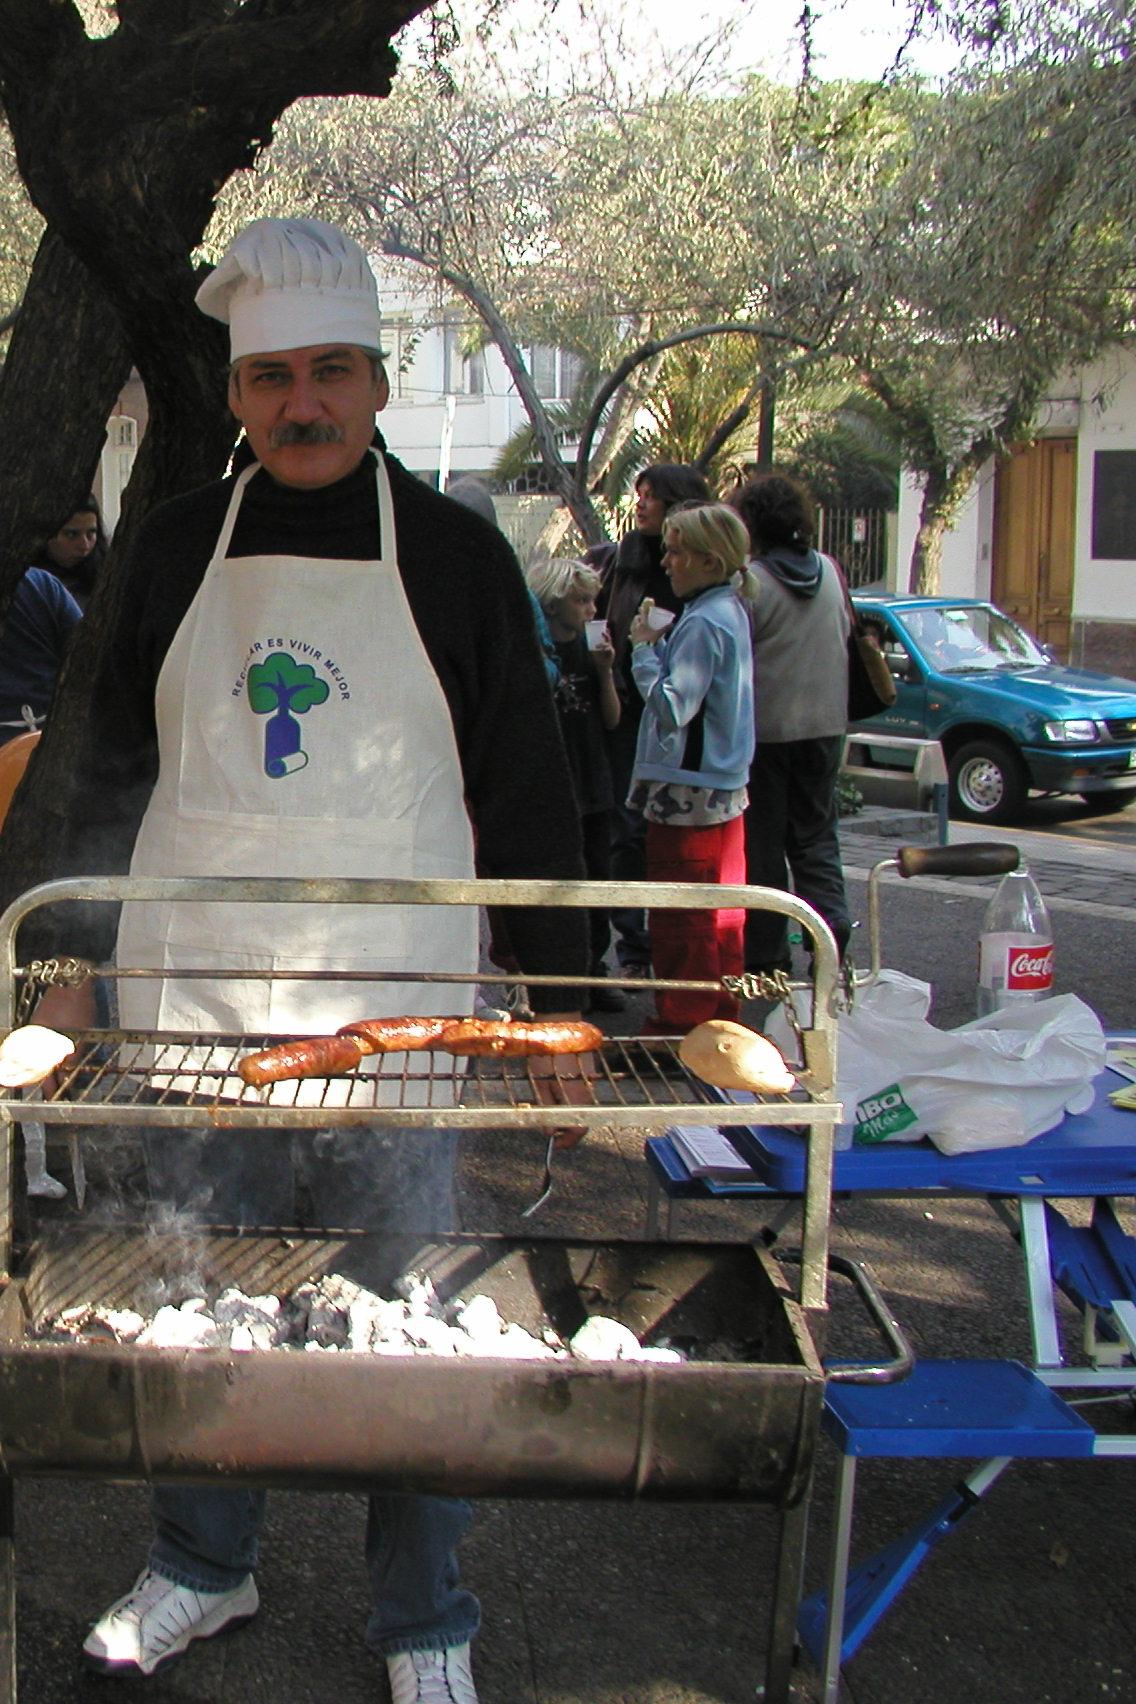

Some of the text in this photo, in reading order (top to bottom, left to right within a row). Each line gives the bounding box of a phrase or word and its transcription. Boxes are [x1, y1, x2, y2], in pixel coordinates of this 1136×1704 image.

[232, 638, 350, 701] RECIAR ES VIVIR MEJOR
